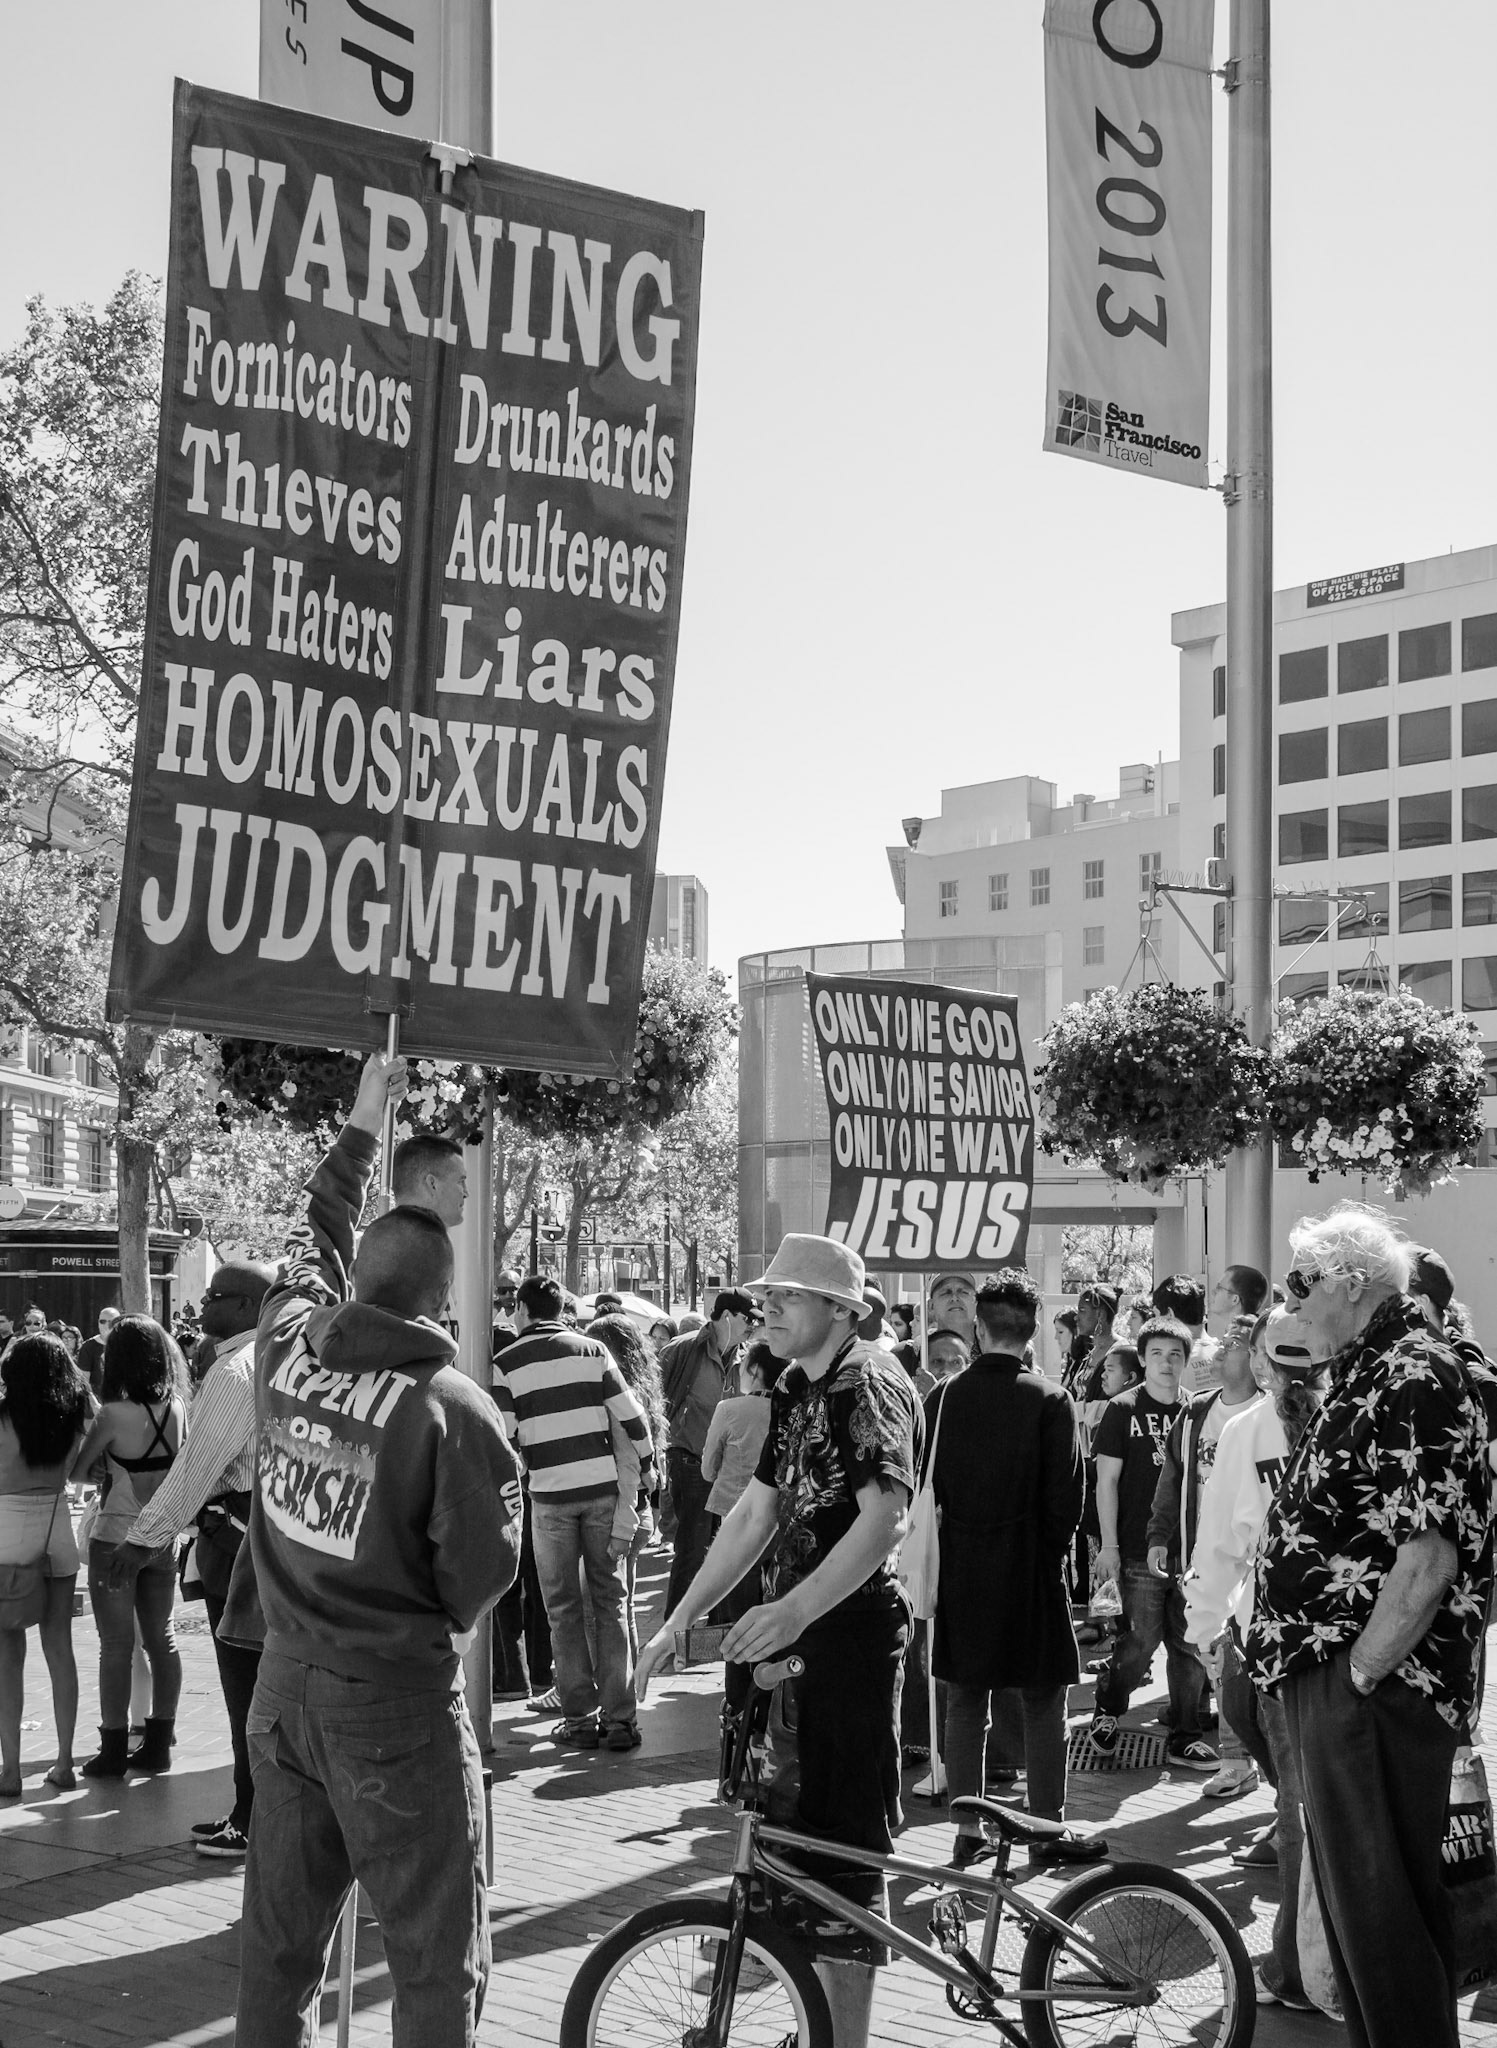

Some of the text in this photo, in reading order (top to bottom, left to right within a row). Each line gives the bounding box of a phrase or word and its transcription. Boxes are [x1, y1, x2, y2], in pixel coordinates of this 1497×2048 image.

[1095, 105, 1167, 348] 2013
[191, 146, 680, 385] WARNING
[183, 306, 412, 448] Fornicators
[1105, 402, 1144, 428] San
[455, 375, 675, 499] Drunkards
[1104, 438, 1153, 467] Travel
[1105, 421, 1201, 459] Francisco
[180, 423, 402, 564] Thieves
[446, 493, 667, 613] Adulterers
[1312, 566, 1400, 589] ONE HALLIDIE PLAZA
[1313, 573, 1399, 597] OFFICE SPACE
[168, 538, 393, 681] God Haters
[1328, 584, 1382, 602] 421-7640
[436, 604, 655, 721] Liars
[156, 662, 648, 849] HOMOSEXUALS
[141, 803, 632, 1005] JUDGMENT
[815, 990, 1016, 1061] ONLY ONE GOD
[827, 1050, 1031, 1118] ONLY ONE SAVIOR
[835, 1112, 1030, 1175] ONLY ONE WAY
[828, 1176, 1028, 1260] JESUS
[52, 1257, 120, 1268] POWELL STREE
[289, 1416, 333, 1448] OR
